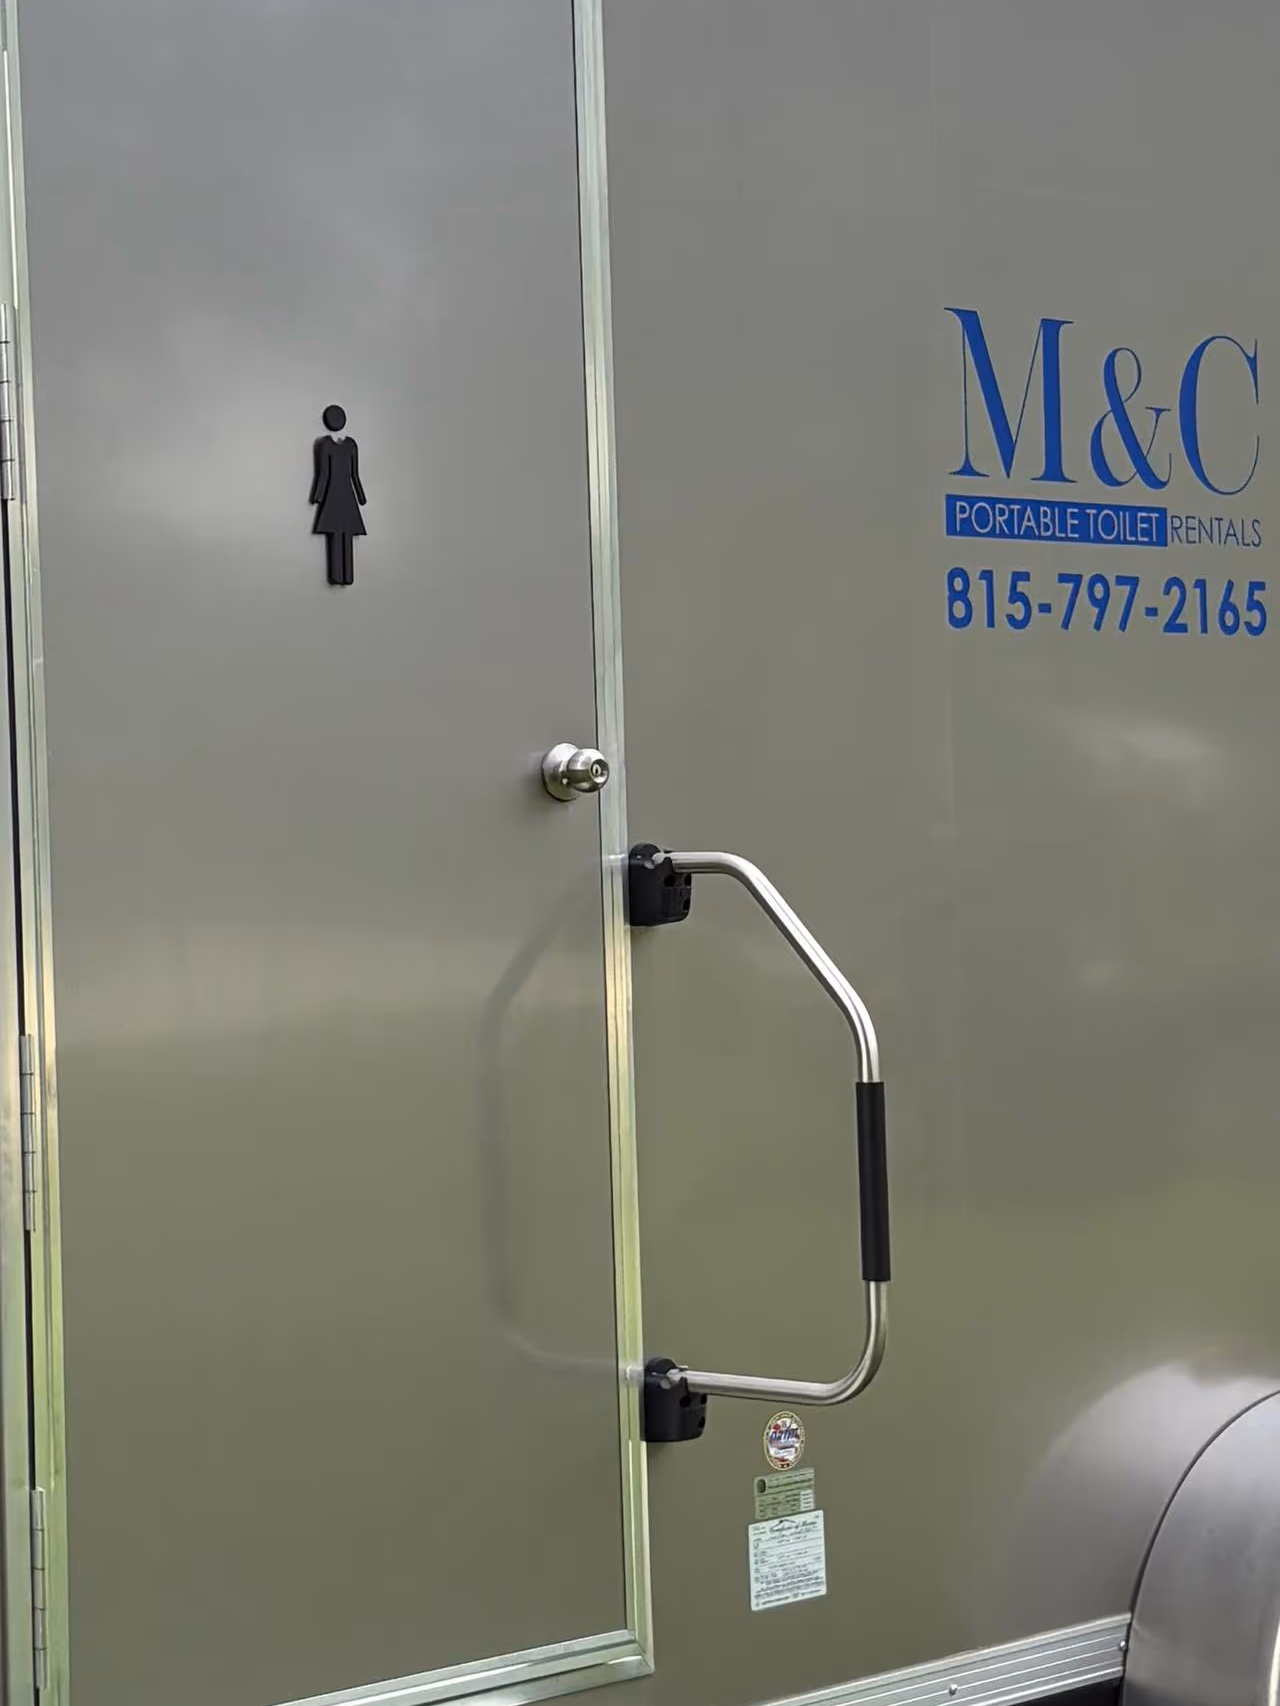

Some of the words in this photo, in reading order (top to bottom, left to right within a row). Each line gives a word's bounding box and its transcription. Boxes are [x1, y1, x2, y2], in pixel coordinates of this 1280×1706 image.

[943, 306, 1260, 496] M&C
[955, 501, 1080, 538] PORTABLE
[1085, 508, 1160, 543] TOILET
[1171, 516, 1262, 548] RENTALS
[945, 566, 1268, 637] 815-797-2165
